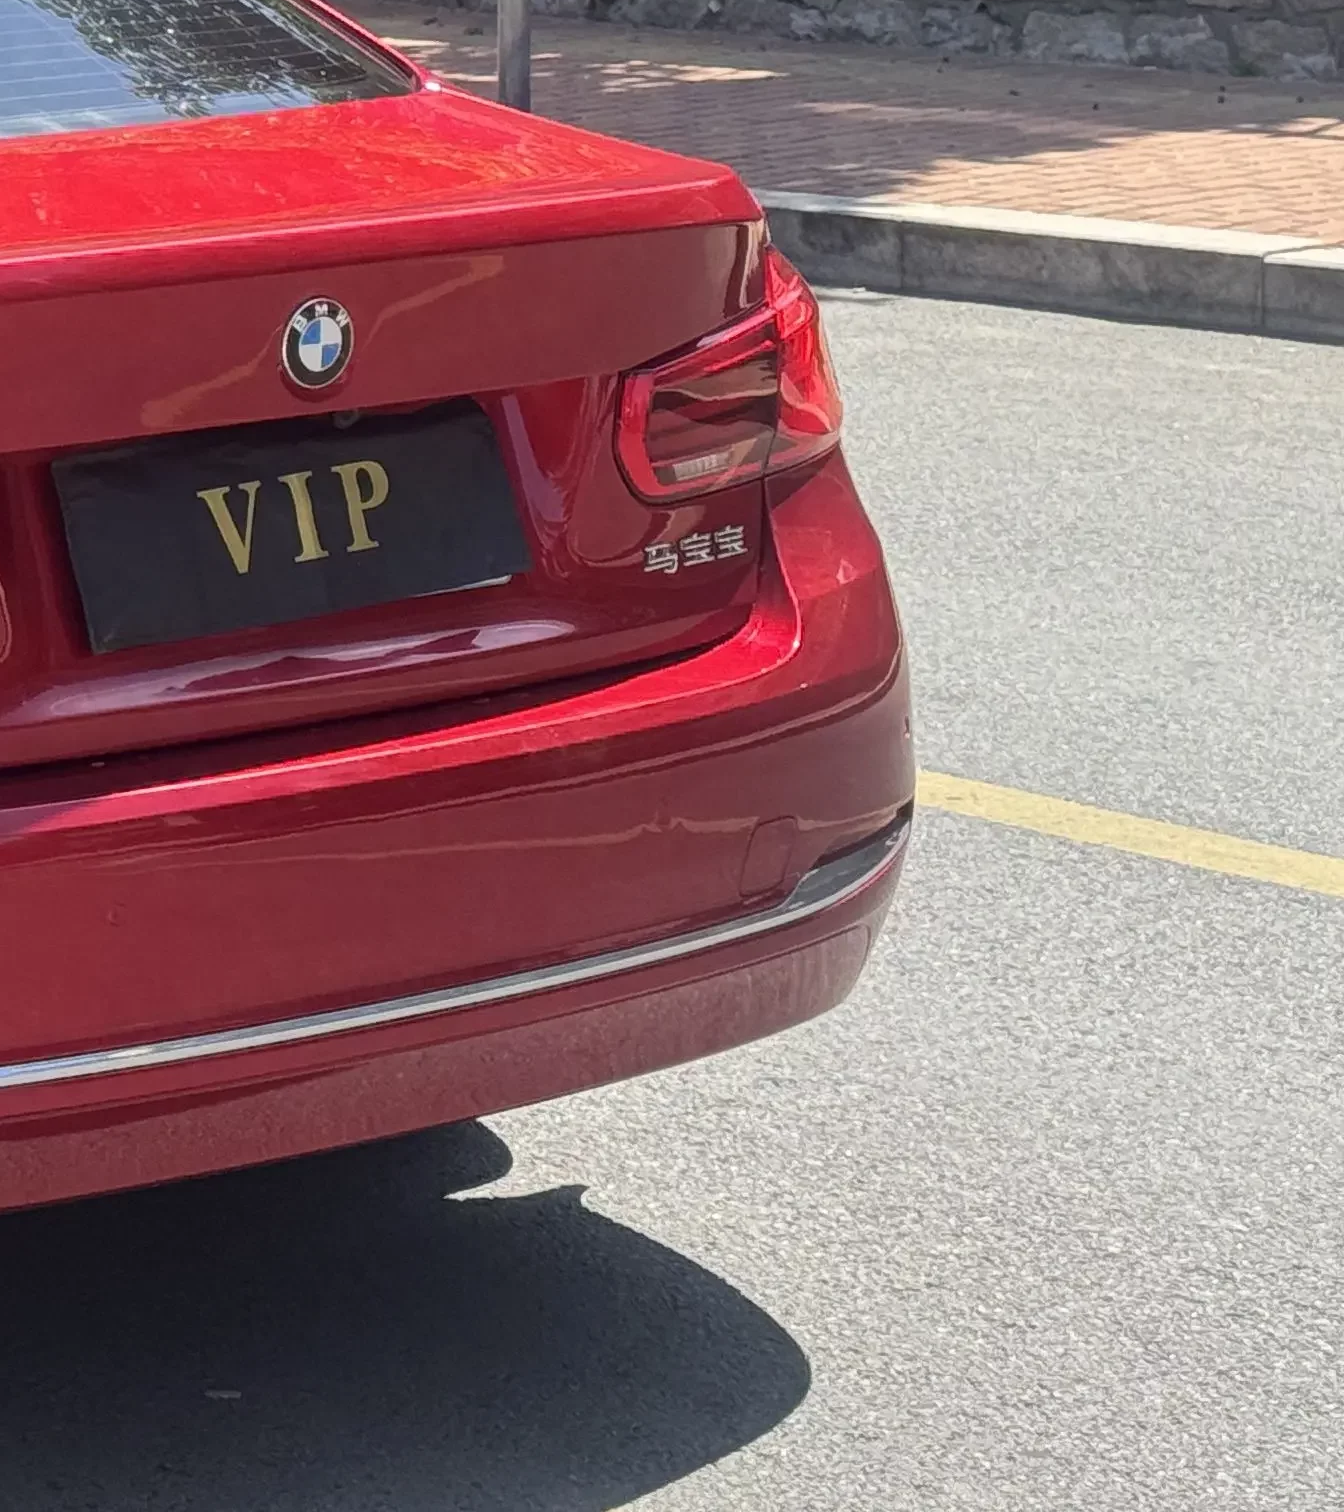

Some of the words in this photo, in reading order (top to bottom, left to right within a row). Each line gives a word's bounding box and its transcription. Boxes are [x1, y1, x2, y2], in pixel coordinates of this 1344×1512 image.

[292, 302, 350, 335] BMW
[195, 459, 390, 575] VIP
[643, 524, 749, 575] 马宝宝
